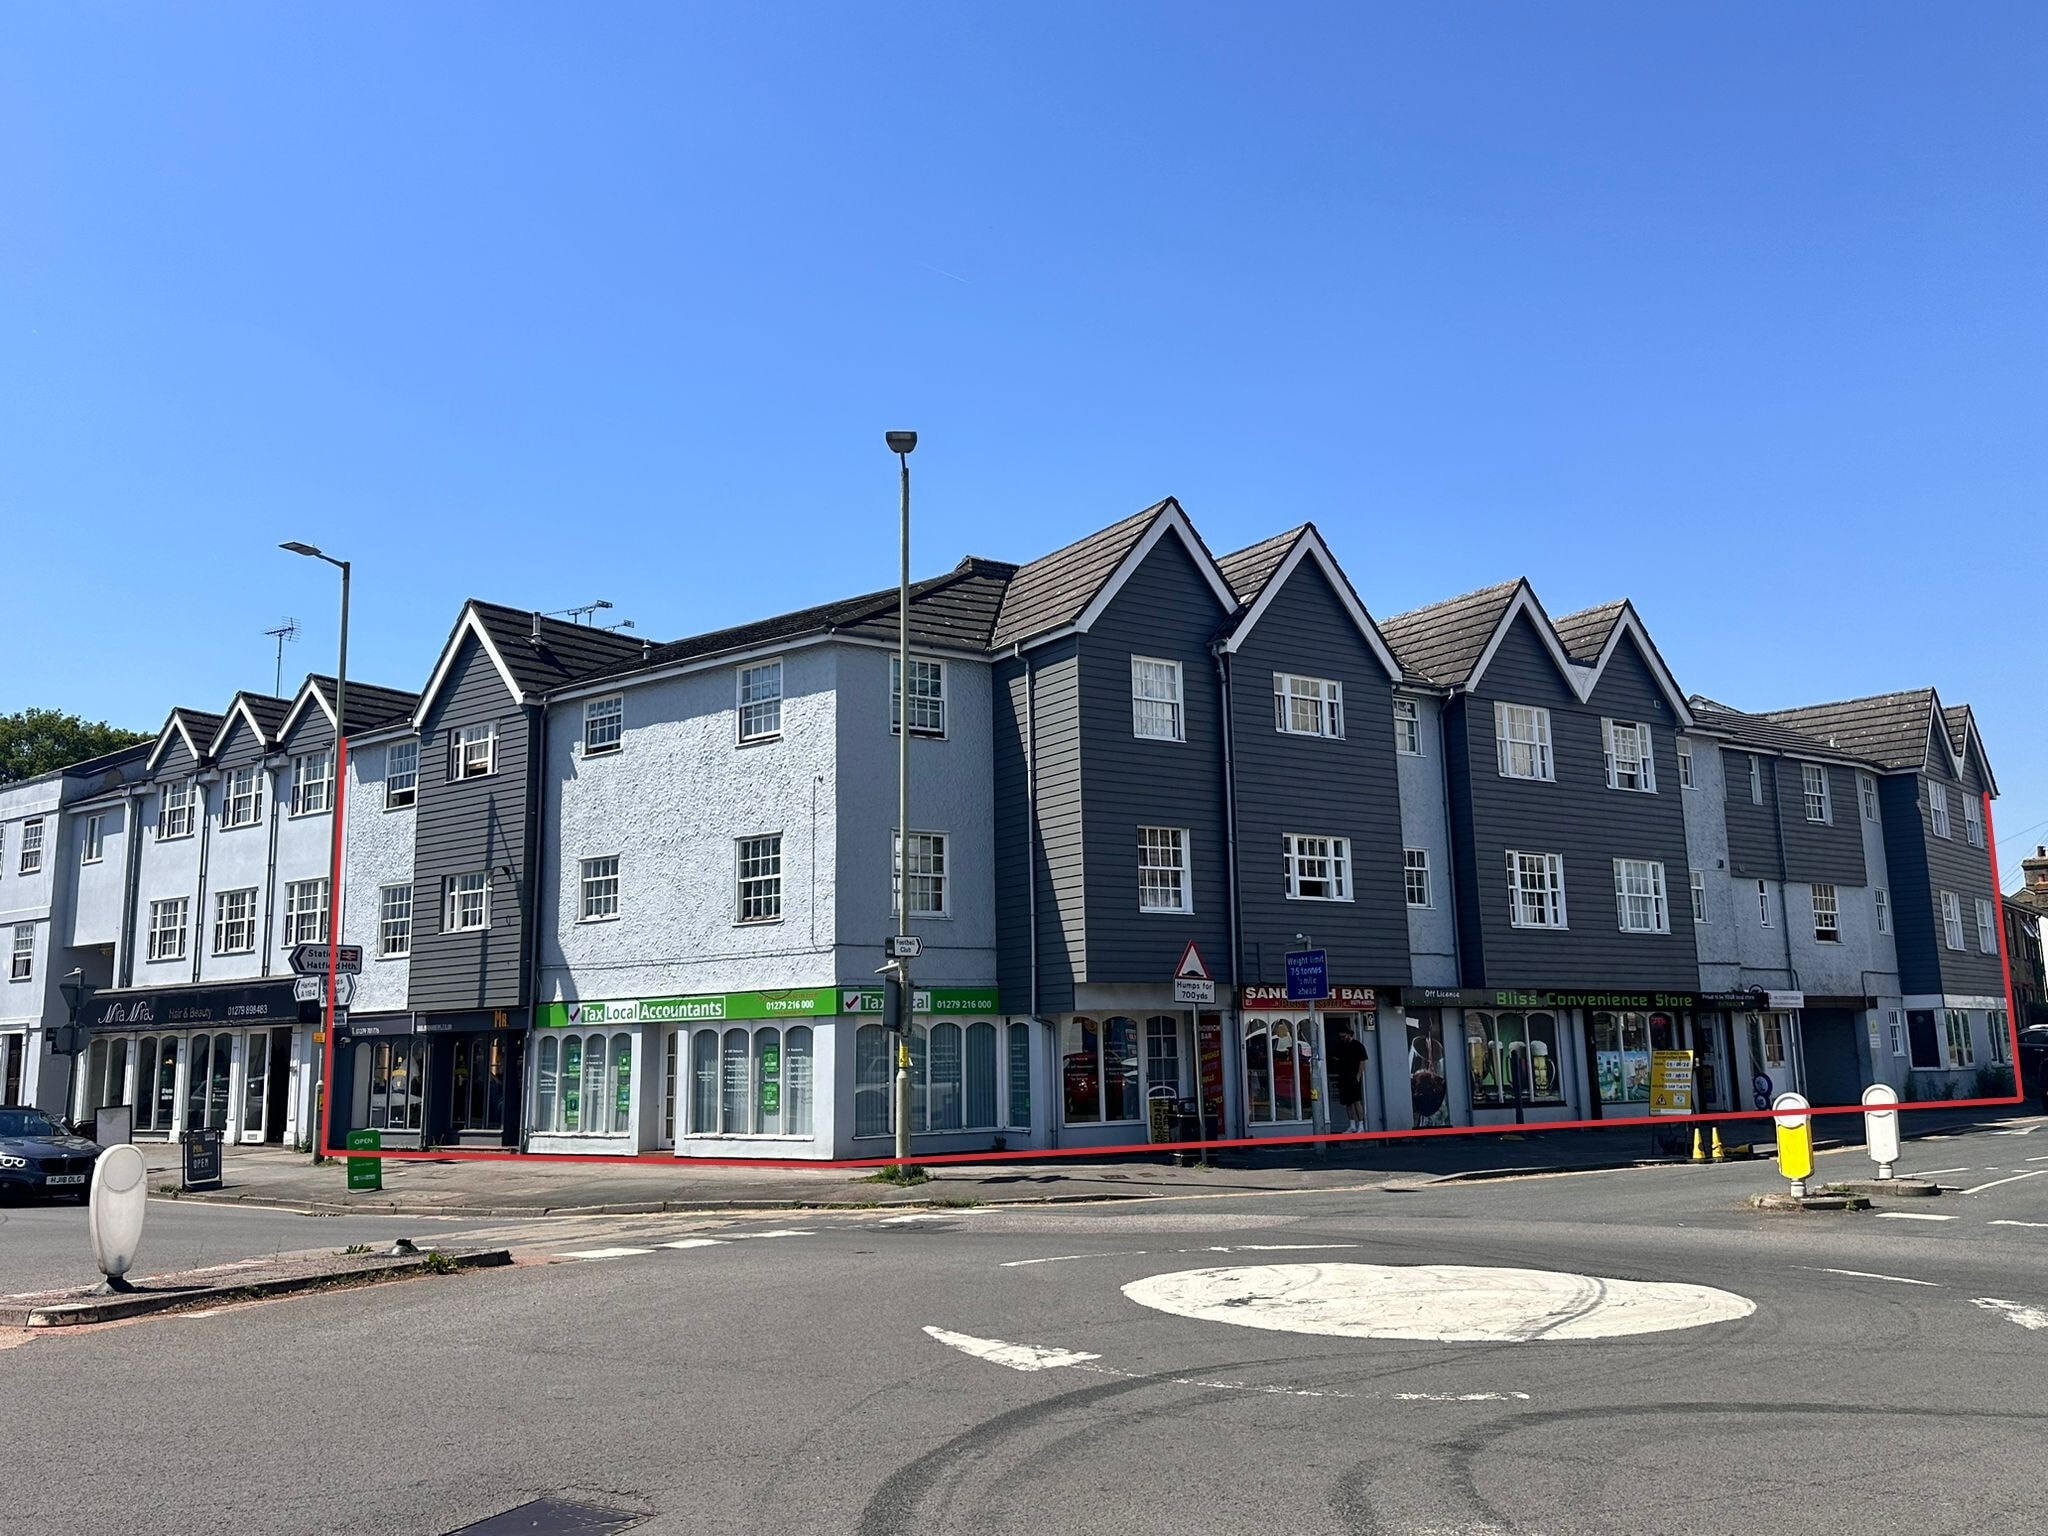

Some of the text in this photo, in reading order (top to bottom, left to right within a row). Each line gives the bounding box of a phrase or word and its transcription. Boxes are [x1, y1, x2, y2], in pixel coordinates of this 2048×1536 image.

[307, 949, 339, 958] Statin
[1176, 981, 1212, 990] Humps for
[1341, 988, 1375, 1000] BAR
[1424, 990, 1435, 998] Off
[1496, 992, 1693, 1007] Bliss Convenience Store
[937, 1000, 961, 1009] 01279
[962, 1000, 976, 1009] 216
[977, 1000, 992, 1009] 000
[227, 1005, 245, 1015] 01279
[583, 1000, 815, 1023] Tax Local Accountants 01279 216 000
[354, 1137, 373, 1145] OPEN
[193, 1158, 209, 1169] OPEN
